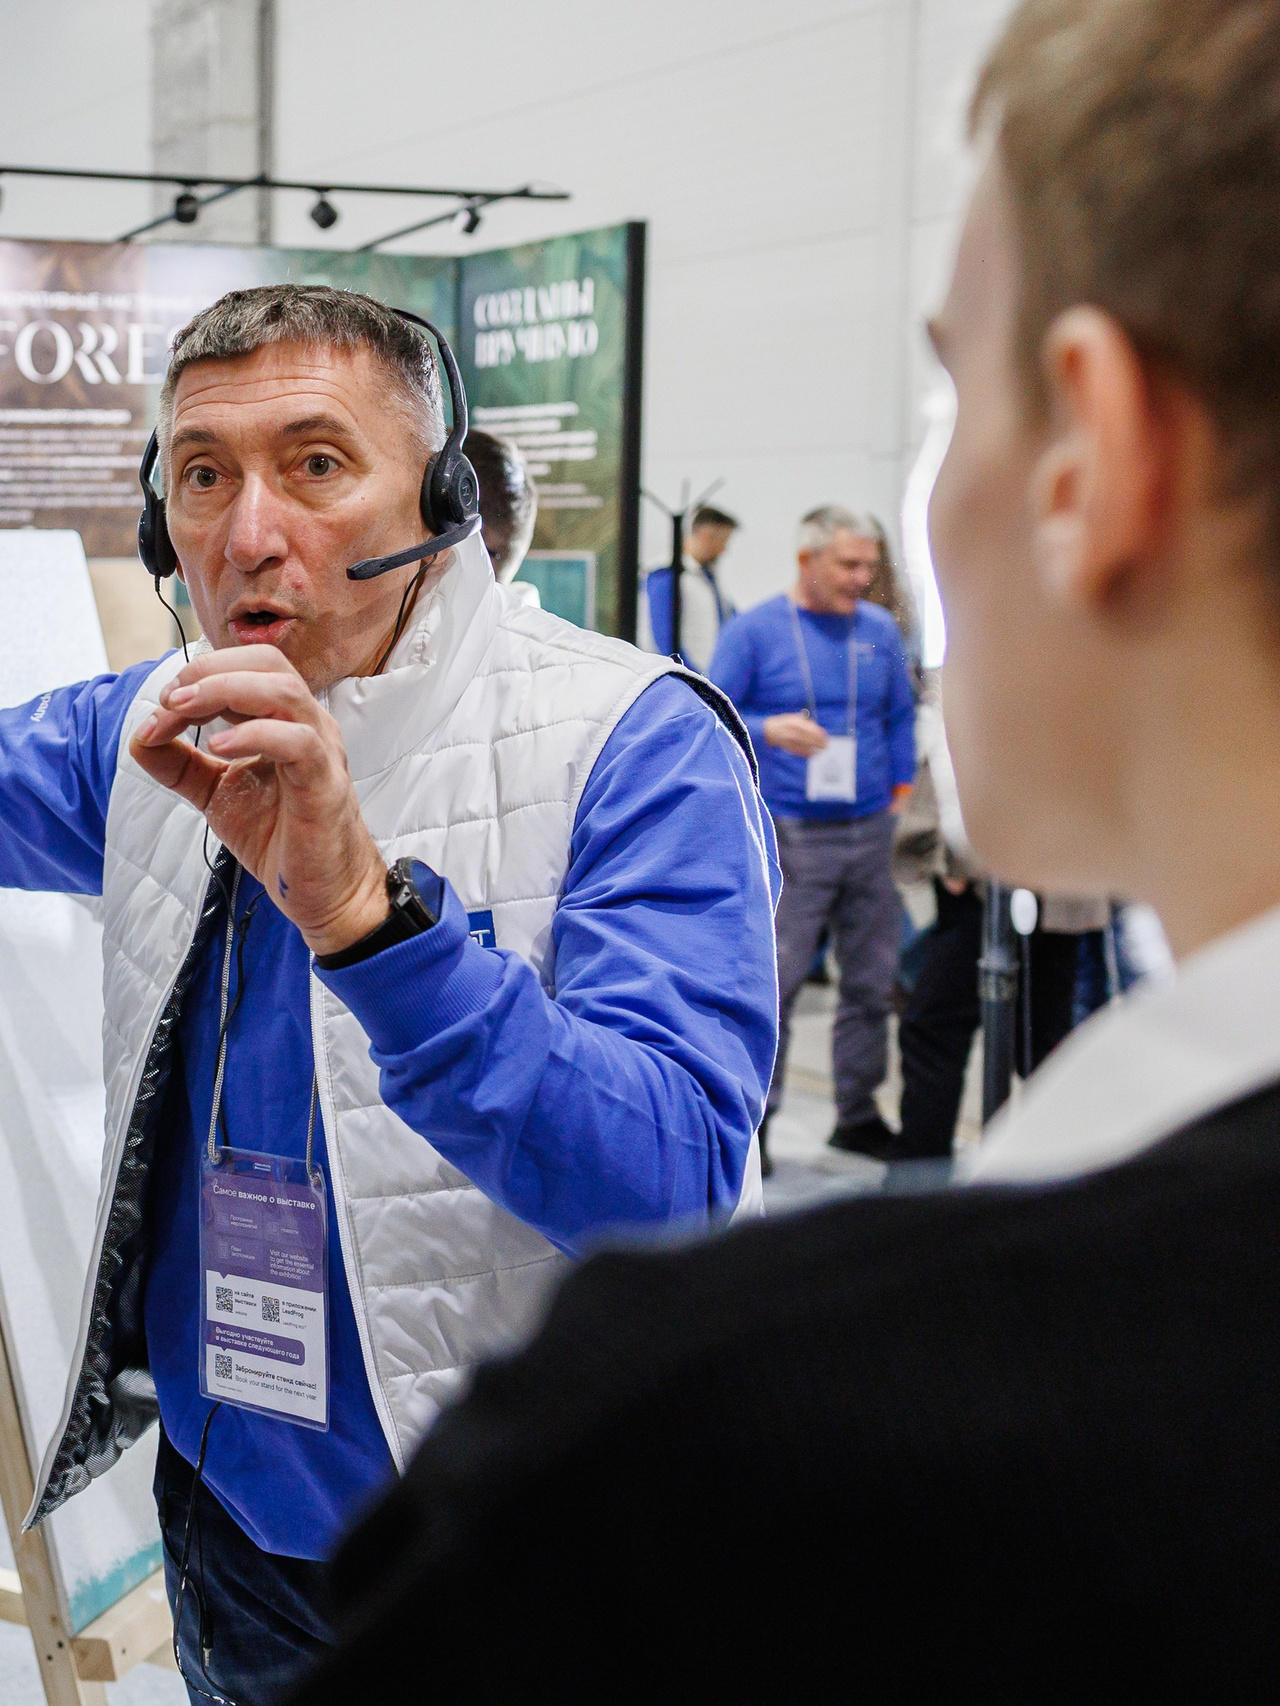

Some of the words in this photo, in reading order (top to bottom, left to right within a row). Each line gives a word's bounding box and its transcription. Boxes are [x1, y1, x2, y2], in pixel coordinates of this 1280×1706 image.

[213, 1185, 236, 1197] Самое
[238, 1191, 267, 1202] важное
[277, 1198, 316, 1210] выставке
[216, 1327, 240, 1338] Выгодно
[241, 1332, 273, 1346] участвуйте
[221, 1337, 247, 1347] выставке
[248, 1342, 285, 1356] следующего
[285, 1350, 300, 1360] года
[235, 1364, 275, 1380] Забронируйте
[276, 1376, 294, 1385] стенд
[295, 1380, 317, 1390] сейчас!
[235, 1375, 248, 1383] Book
[261, 1382, 275, 1390] stand
[284, 1387, 292, 1395] the
[293, 1390, 305, 1398] next
